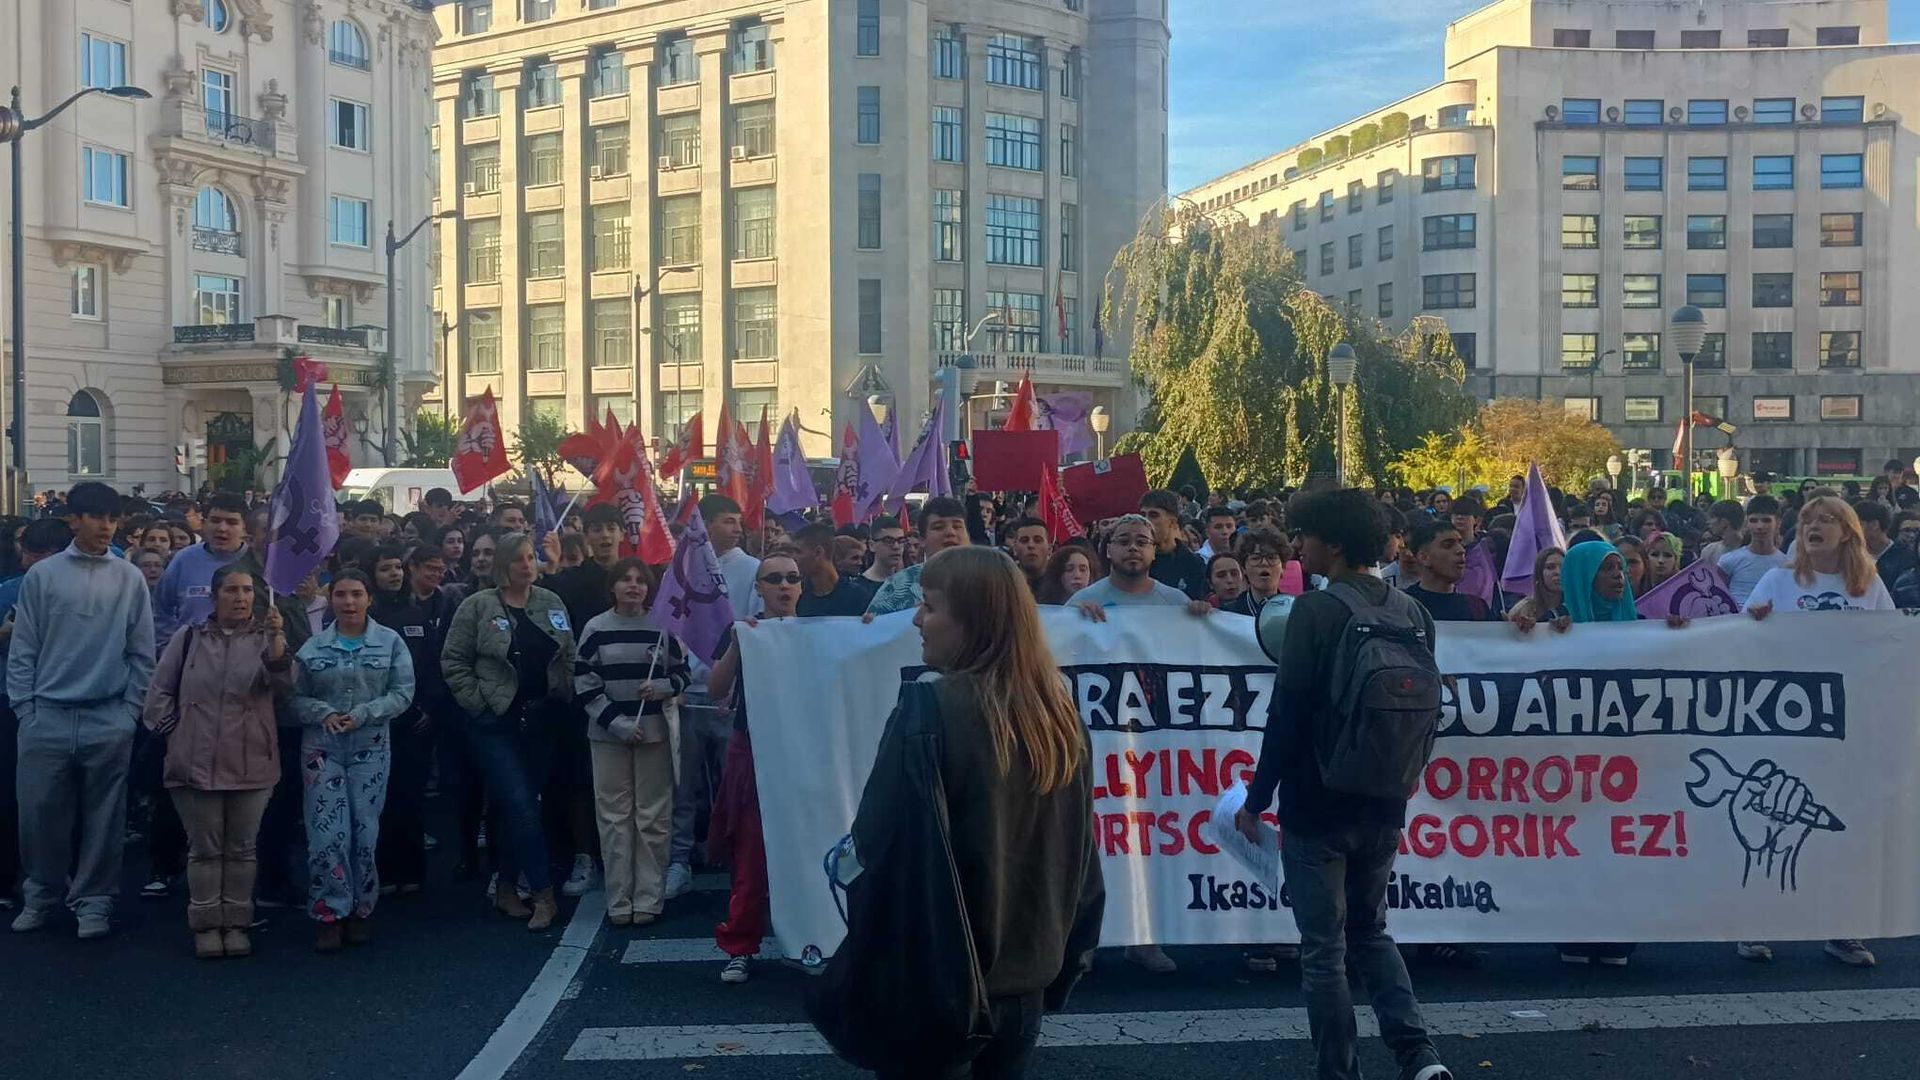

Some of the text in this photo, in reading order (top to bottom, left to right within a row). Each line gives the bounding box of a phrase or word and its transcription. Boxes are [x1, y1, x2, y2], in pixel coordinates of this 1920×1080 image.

[214, 364, 274, 380] CARLTON
[1511, 676, 1834, 735] AHAZTUKO!
[1410, 755, 1639, 803] ORROTO
[1611, 809, 1690, 858] EZ!
